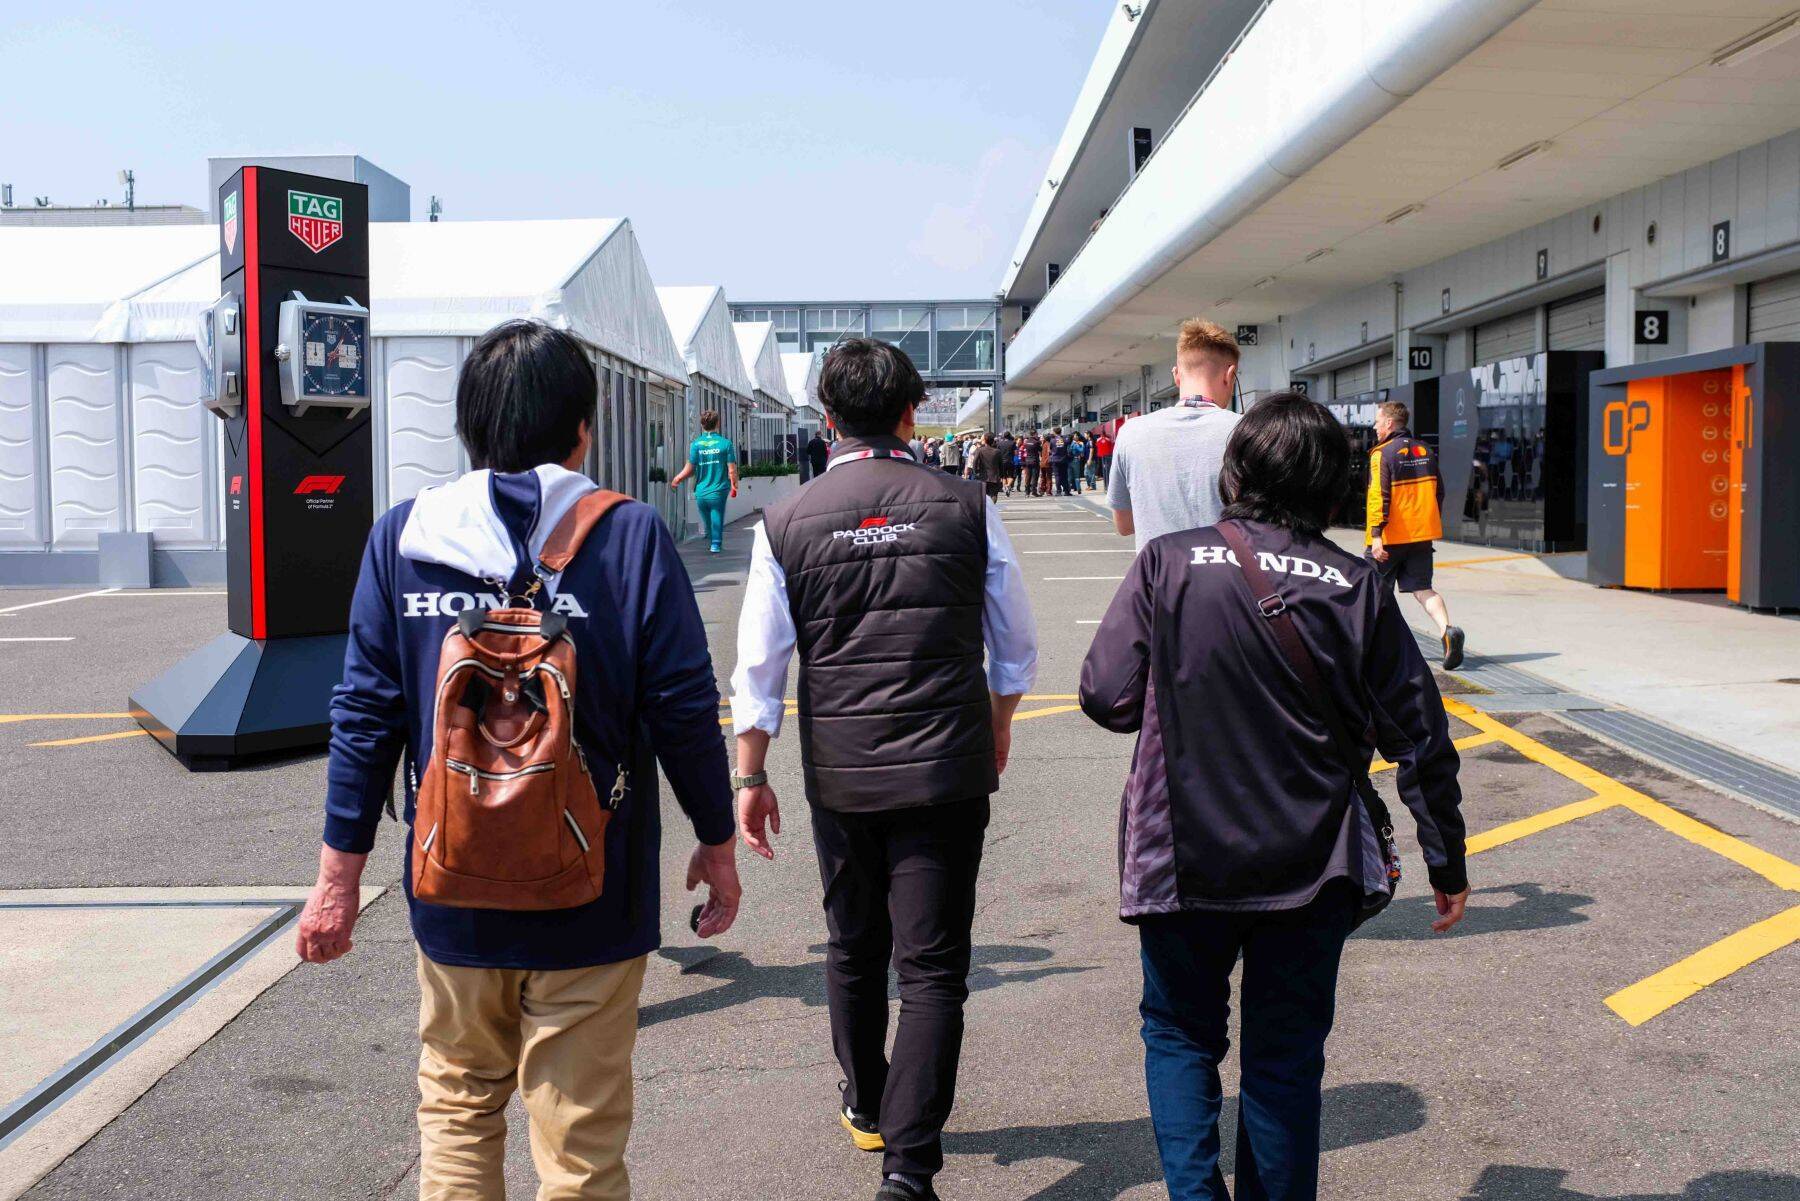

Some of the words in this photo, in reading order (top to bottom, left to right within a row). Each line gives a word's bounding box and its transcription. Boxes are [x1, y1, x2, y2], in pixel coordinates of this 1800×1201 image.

[292, 195, 337, 218] TAG
[291, 217, 339, 248] HEUER
[1716, 229, 1725, 256] 8
[1539, 254, 1546, 276] 9
[1643, 316, 1660, 341] 8
[1411, 350, 1430, 367] 10
[832, 522, 916, 540] PADDOCK
[852, 533, 898, 545] CLUB
[402, 591, 589, 618] HONA
